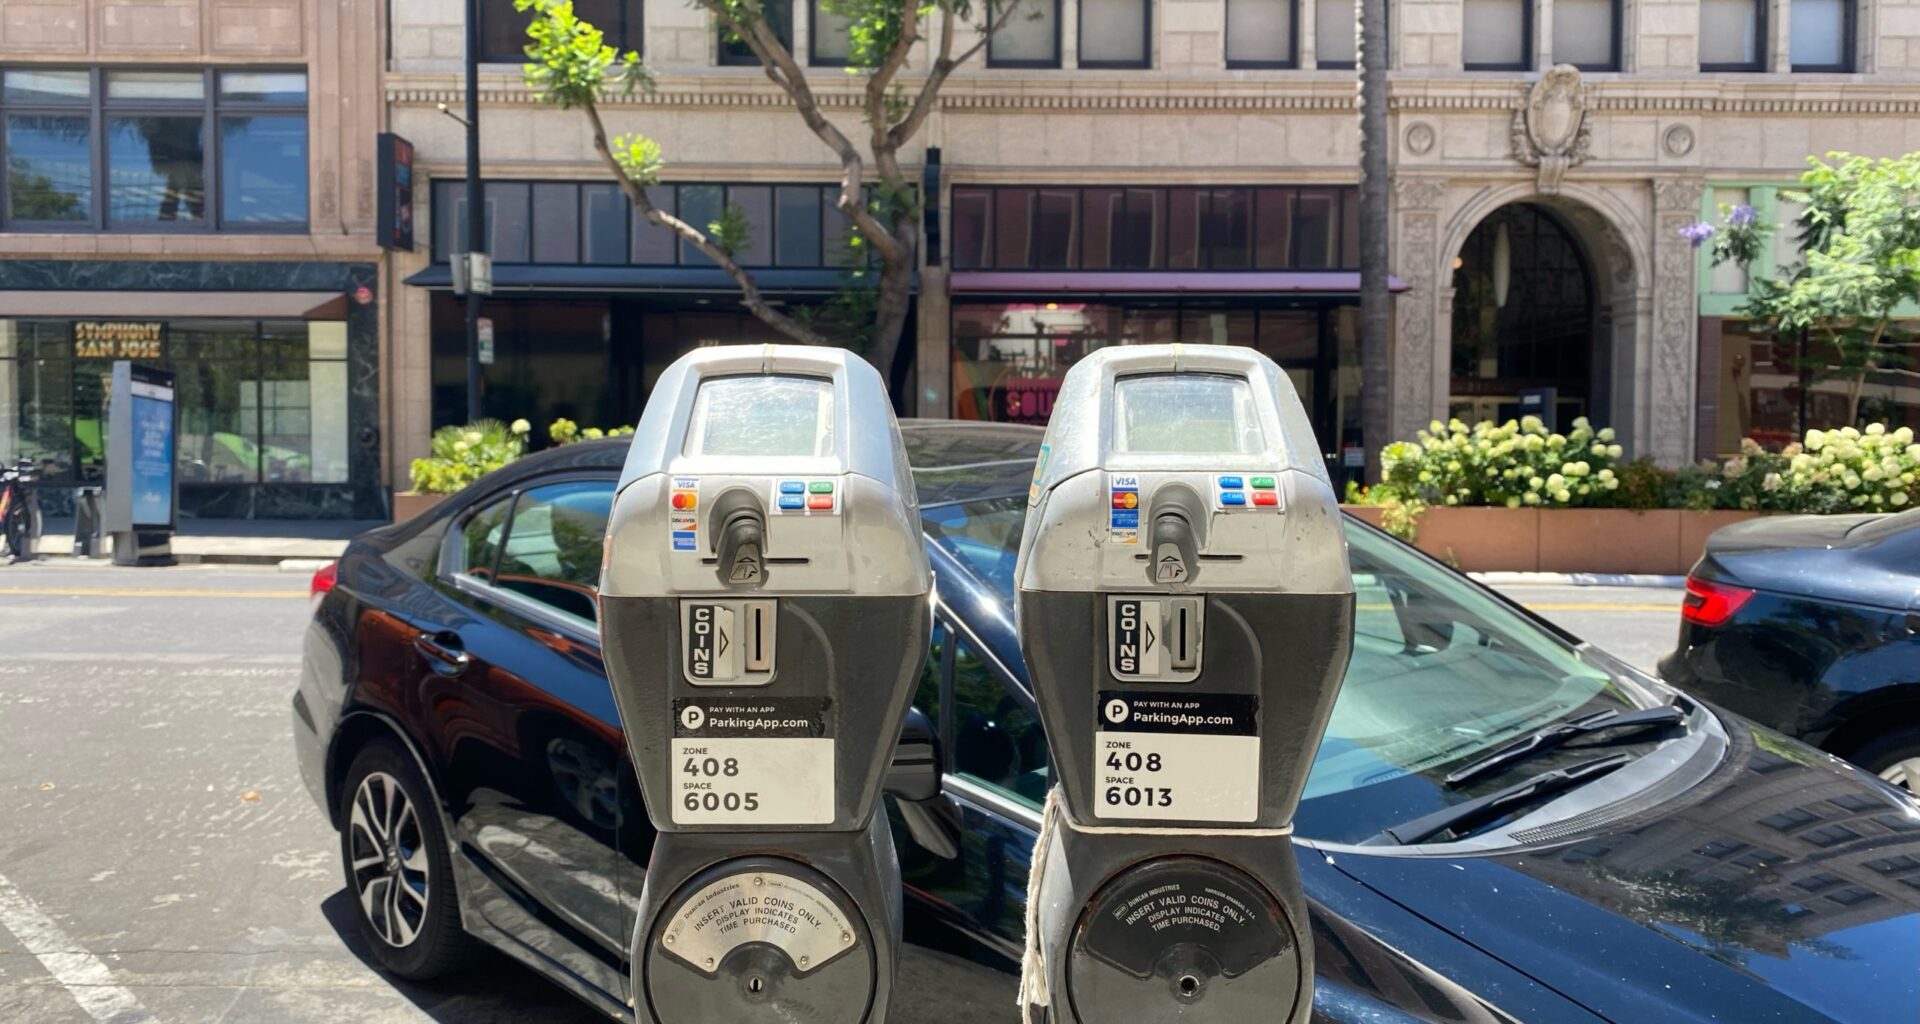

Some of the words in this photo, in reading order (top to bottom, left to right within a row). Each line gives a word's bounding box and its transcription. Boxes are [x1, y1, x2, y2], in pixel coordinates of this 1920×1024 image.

[75, 322, 160, 340] SYMPHONY
[75, 341, 114, 358] SAN
[119, 341, 160, 358] JOSE
[1116, 477, 1136, 486] VISA
[694, 608, 710, 675] COINS
[1119, 604, 1136, 671] COINS
[1112, 705, 1124, 718] P
[1149, 701, 1170, 709] WITH
[688, 711, 700, 724] P
[709, 717, 808, 729] ParkingApp.com
[1133, 712, 1234, 726] ParkingApp.com
[683, 747, 709, 755] ZONE
[1106, 741, 1132, 749] ZONE
[683, 757, 739, 777] 408
[1106, 752, 1162, 772] 408
[683, 782, 712, 790] SPACE
[1105, 776, 1135, 784] SPACE
[684, 792, 759, 811] 6005
[1105, 786, 1172, 807] 6013
[684, 899, 706, 919] Duncan
[705, 883, 740, 901] Industries
[1127, 891, 1150, 908] DUNCAN
[1148, 884, 1180, 897] INDUSTRIES
[694, 905, 725, 932] INSERT
[729, 896, 758, 909] VALID
[763, 896, 795, 911] COINS
[798, 908, 822, 930] ONLY.
[715, 908, 750, 926] DISPLAY
[754, 907, 799, 925] INDICATES
[1125, 901, 1156, 926] INSERT
[1158, 895, 1187, 907] VALID
[1191, 895, 1219, 909] COINS
[1222, 905, 1245, 926] ONLY.
[1147, 906, 1181, 923] DISPLAY
[1184, 906, 1225, 923] INDICATES
[719, 922, 739, 935] TIME
[743, 917, 797, 935] PURCHASED.
[1151, 919, 1171, 932] TIME
[1171, 916, 1220, 932] PURCHASED.
